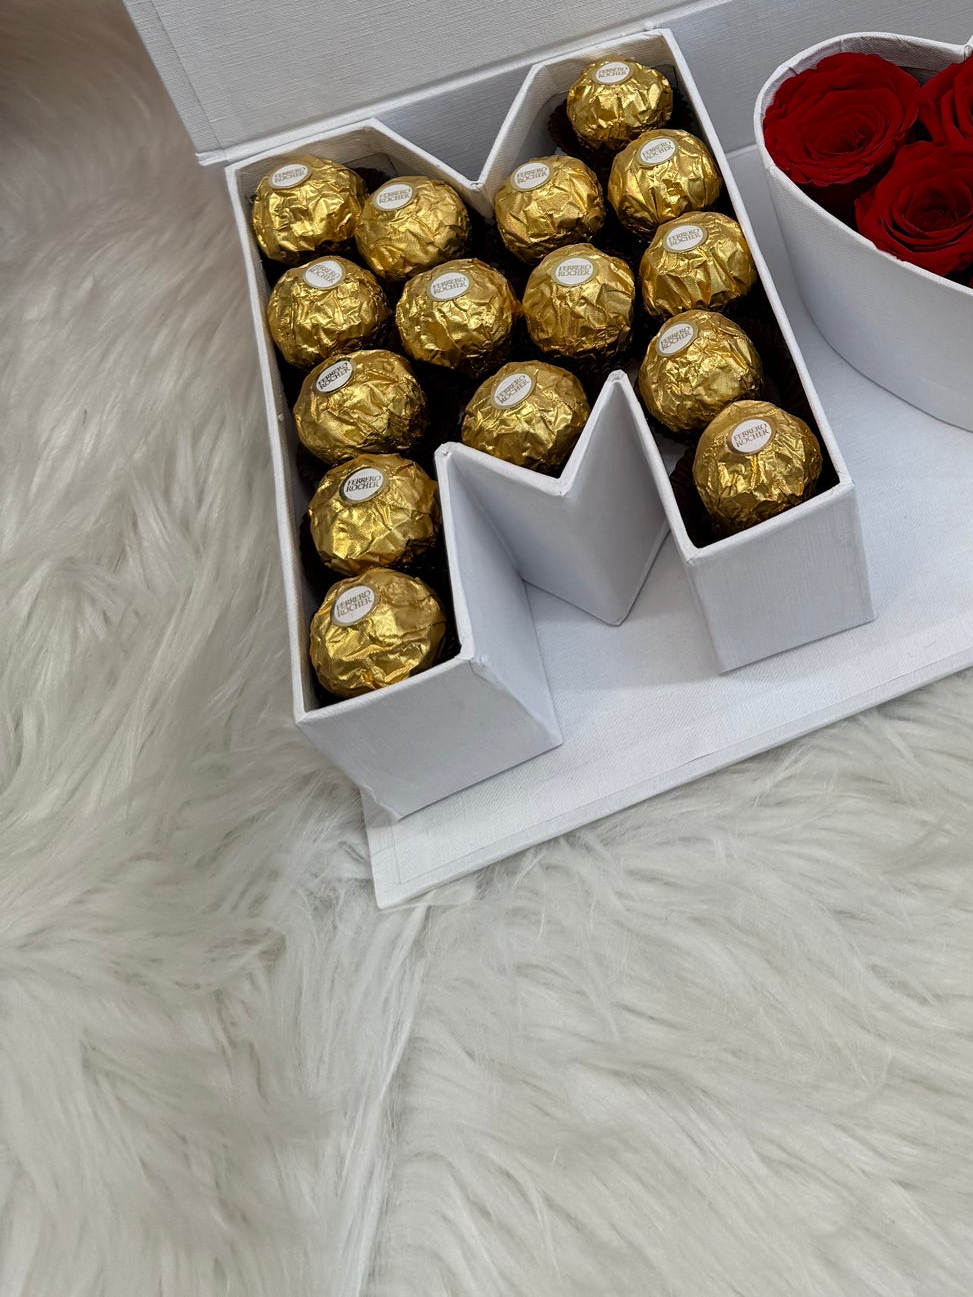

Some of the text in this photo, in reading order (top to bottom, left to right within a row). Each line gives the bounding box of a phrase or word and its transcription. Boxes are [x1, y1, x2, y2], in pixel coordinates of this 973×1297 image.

[318, 362, 348, 385] FERRERO
[320, 367, 349, 390] ROCHER
[734, 424, 767, 441] FERRERO
[736, 429, 768, 447] ROCHER
[346, 483, 379, 492] ROCHER
[348, 475, 381, 485] FERRERO
[336, 590, 370, 610] FERRERO
[337, 597, 372, 617] ROCHER
